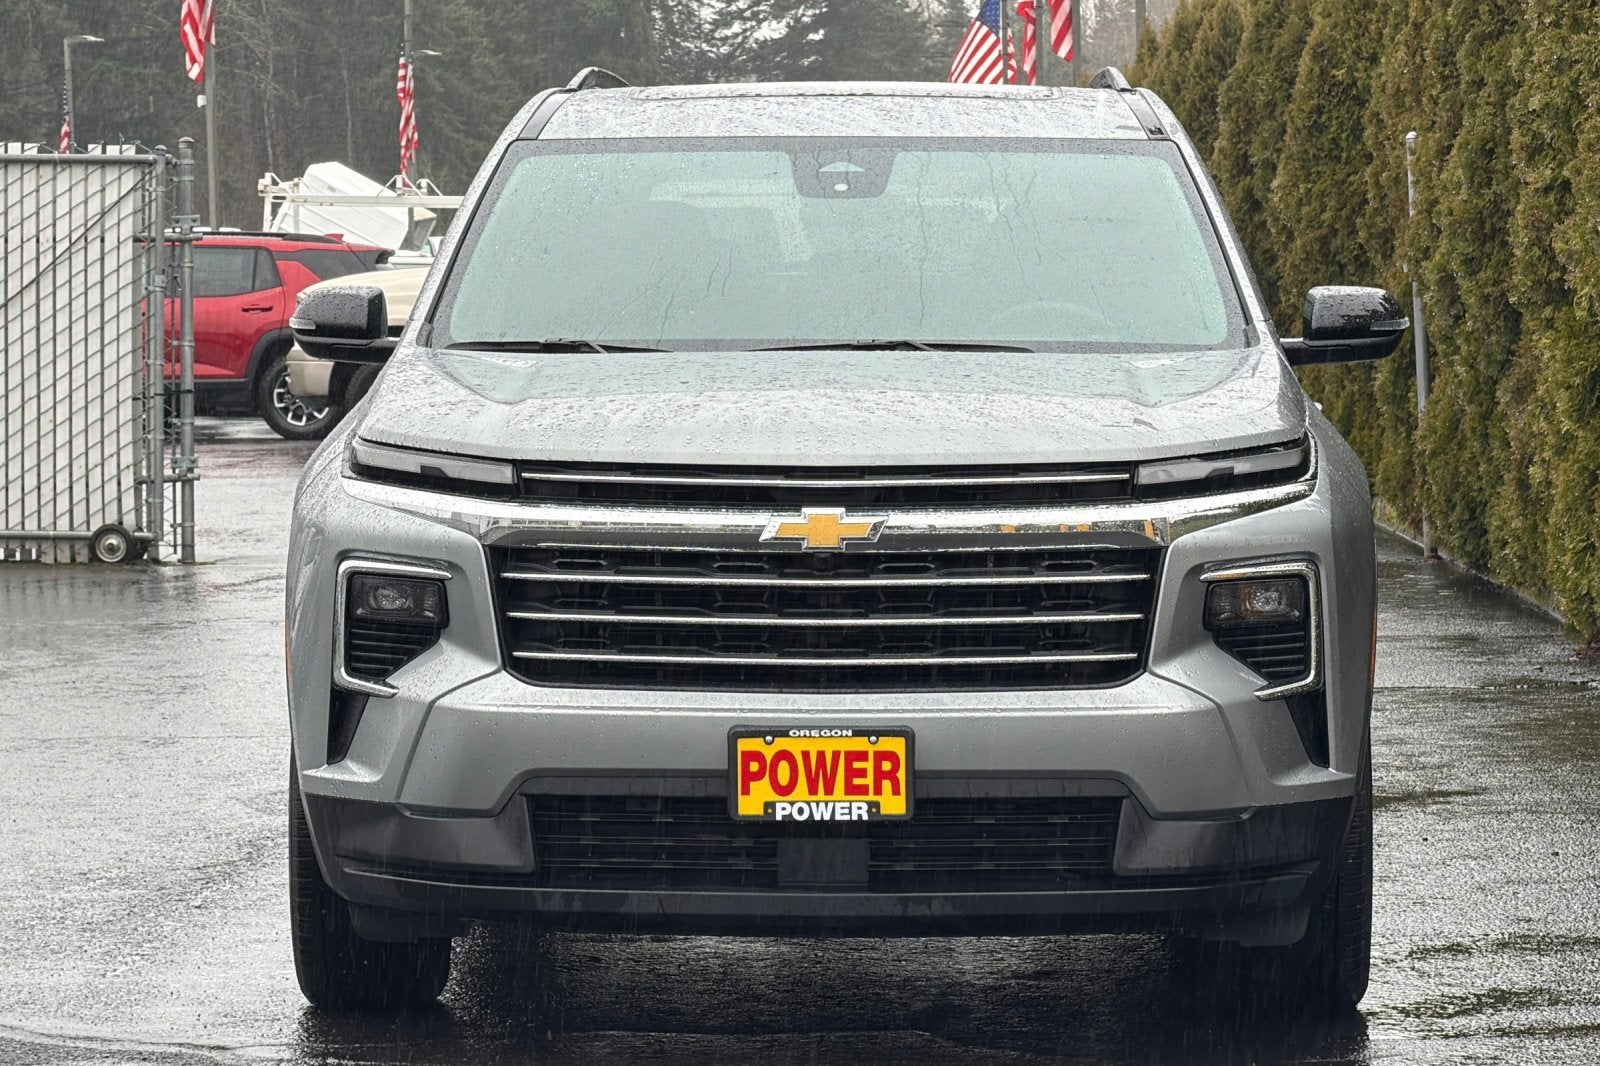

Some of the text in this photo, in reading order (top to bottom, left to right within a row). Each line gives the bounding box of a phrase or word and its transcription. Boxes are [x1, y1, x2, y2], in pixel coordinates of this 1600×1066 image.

[789, 729, 853, 737] OREGON
[740, 749, 901, 797] POWER
[775, 801, 869, 821] POWER
